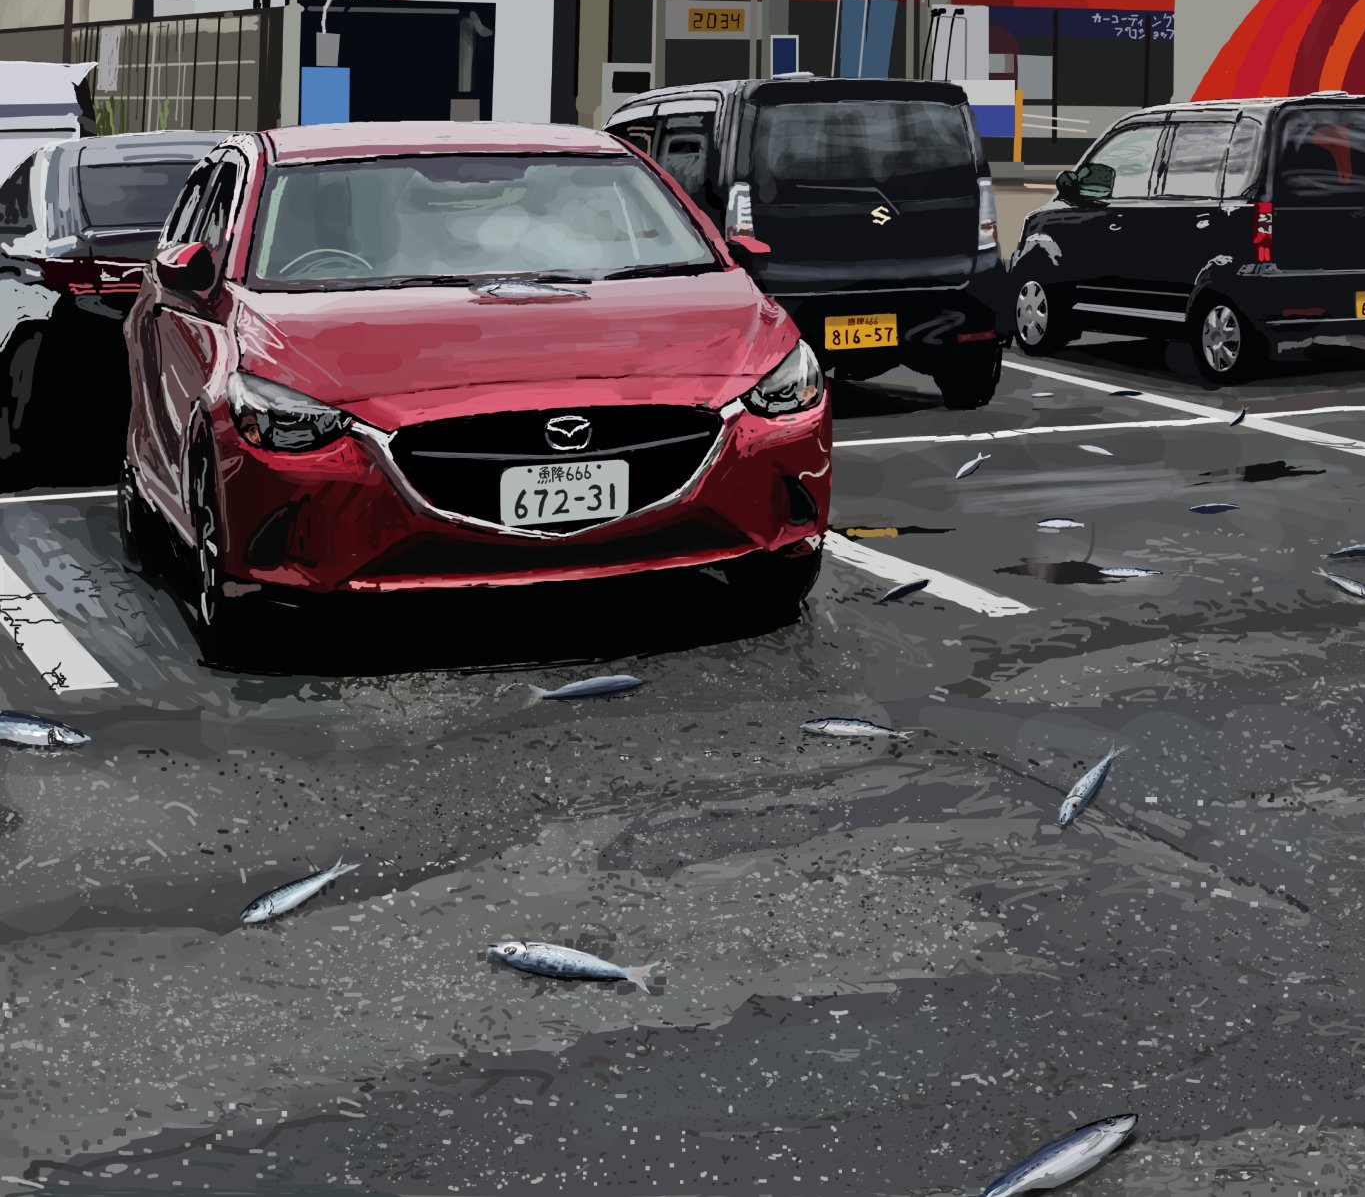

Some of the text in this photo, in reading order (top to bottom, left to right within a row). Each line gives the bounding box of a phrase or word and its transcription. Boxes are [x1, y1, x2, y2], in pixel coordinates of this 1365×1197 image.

[693, 12, 741, 29] 2034
[832, 327, 893, 346] 816-57
[514, 482, 616, 519] 672-31
